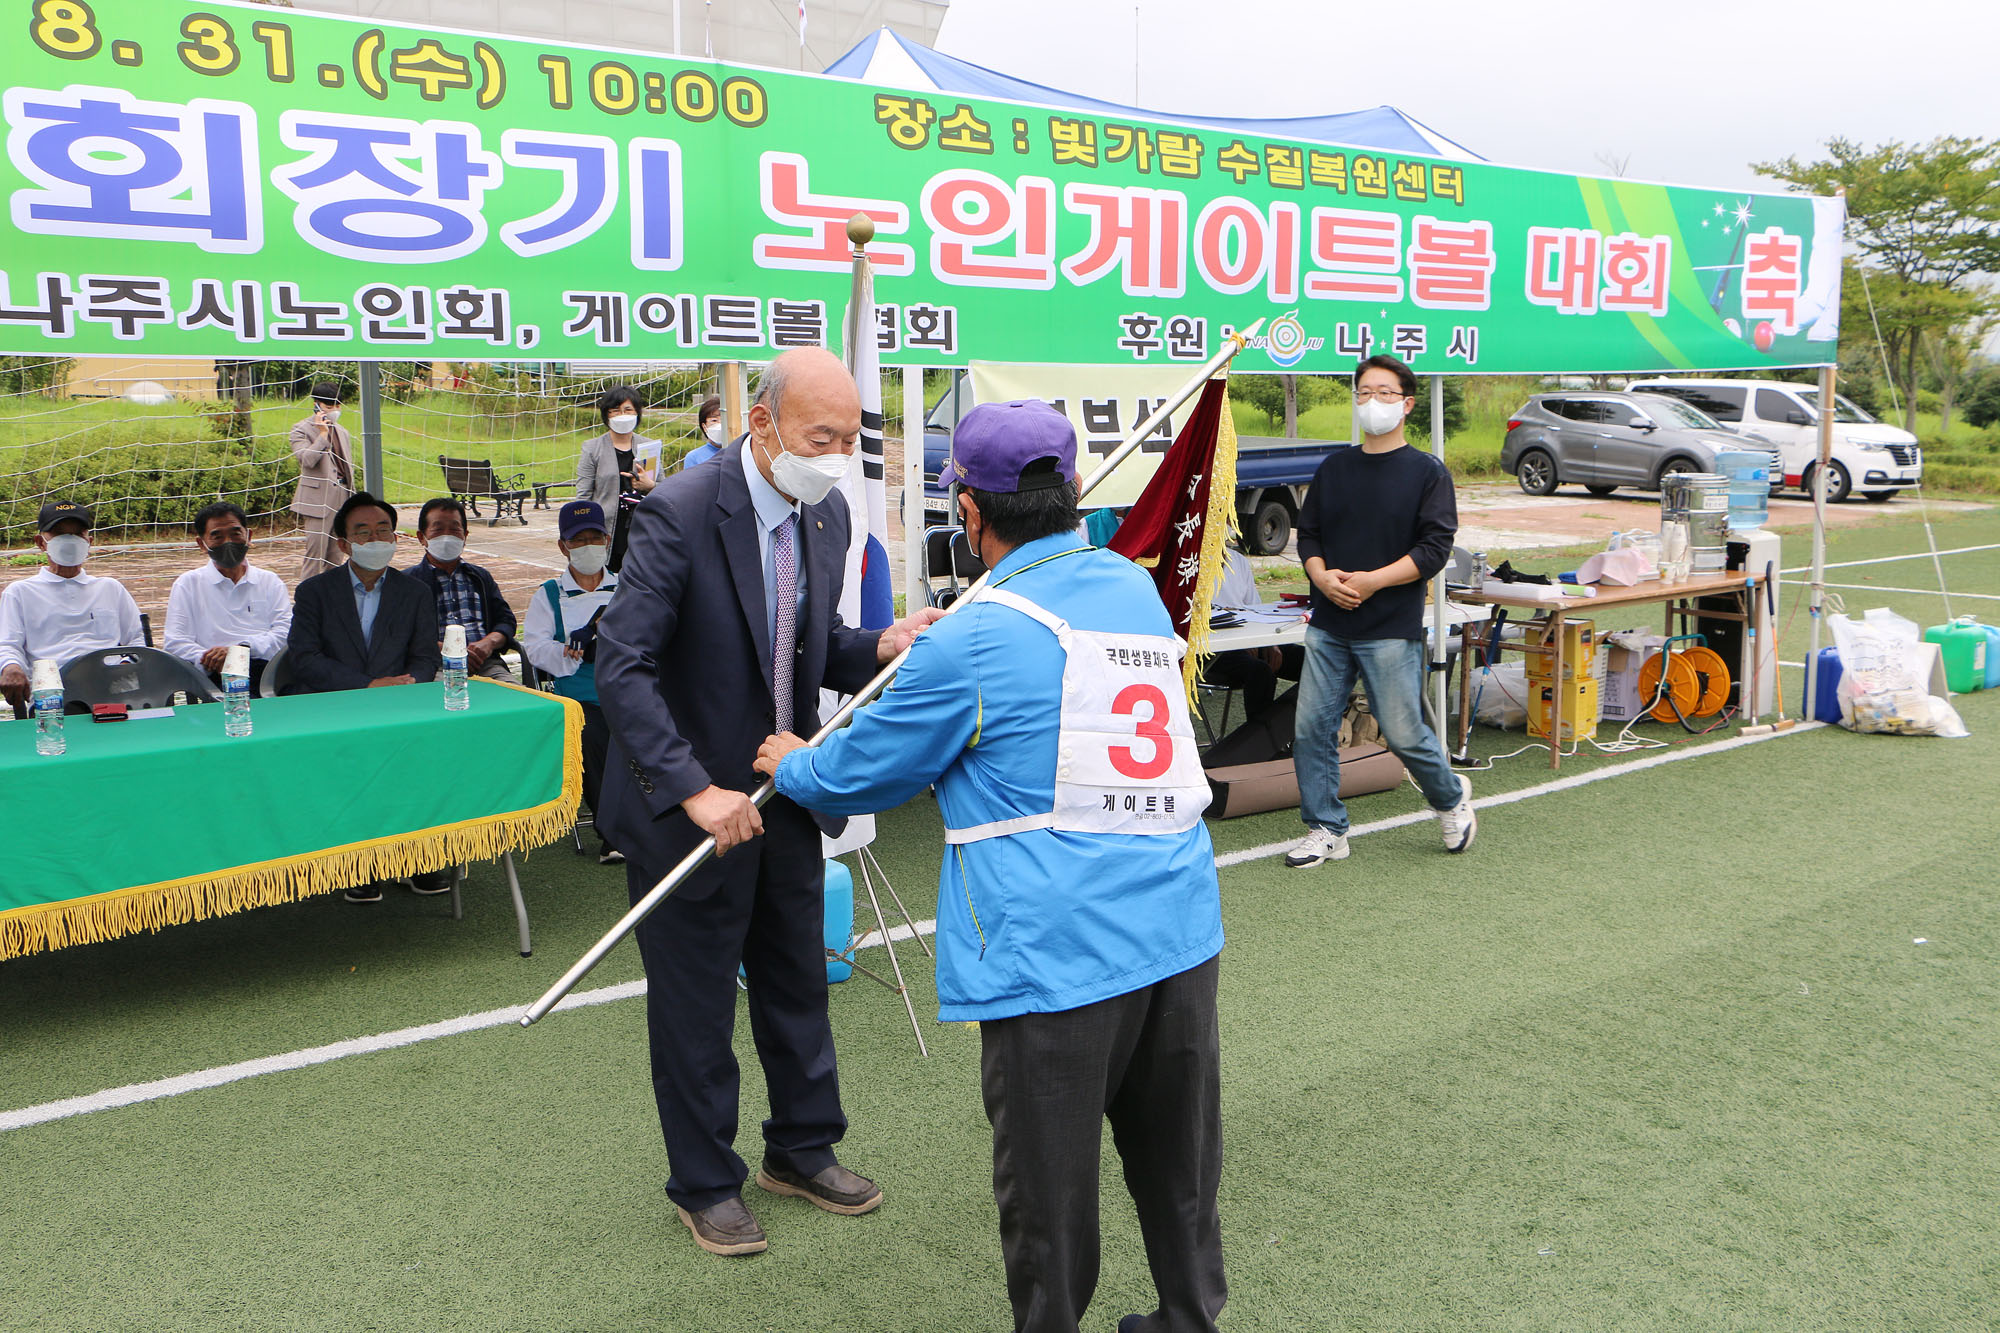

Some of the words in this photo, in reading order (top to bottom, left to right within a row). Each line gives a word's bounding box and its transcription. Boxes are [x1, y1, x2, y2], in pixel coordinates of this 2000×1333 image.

[540, 56, 766, 126] 10:00
[876, 96, 993, 153] 장소
[1050, 118, 1203, 177] 빛가람
[1218, 142, 1464, 203] 수질복원센터
[20, 96, 675, 262] 회장기
[763, 160, 1493, 304] 노인게이트볼
[1530, 233, 1668, 312] 대회
[1745, 234, 1798, 328] 축
[569, 294, 823, 347] 게이트볼
[1120, 315, 1204, 358] 후원
[1050, 399, 1173, 472] 부석
[1106, 648, 1170, 669] 국민생활체육
[1107, 683, 1174, 781] 3
[1102, 794, 1175, 813] 게이트볼
